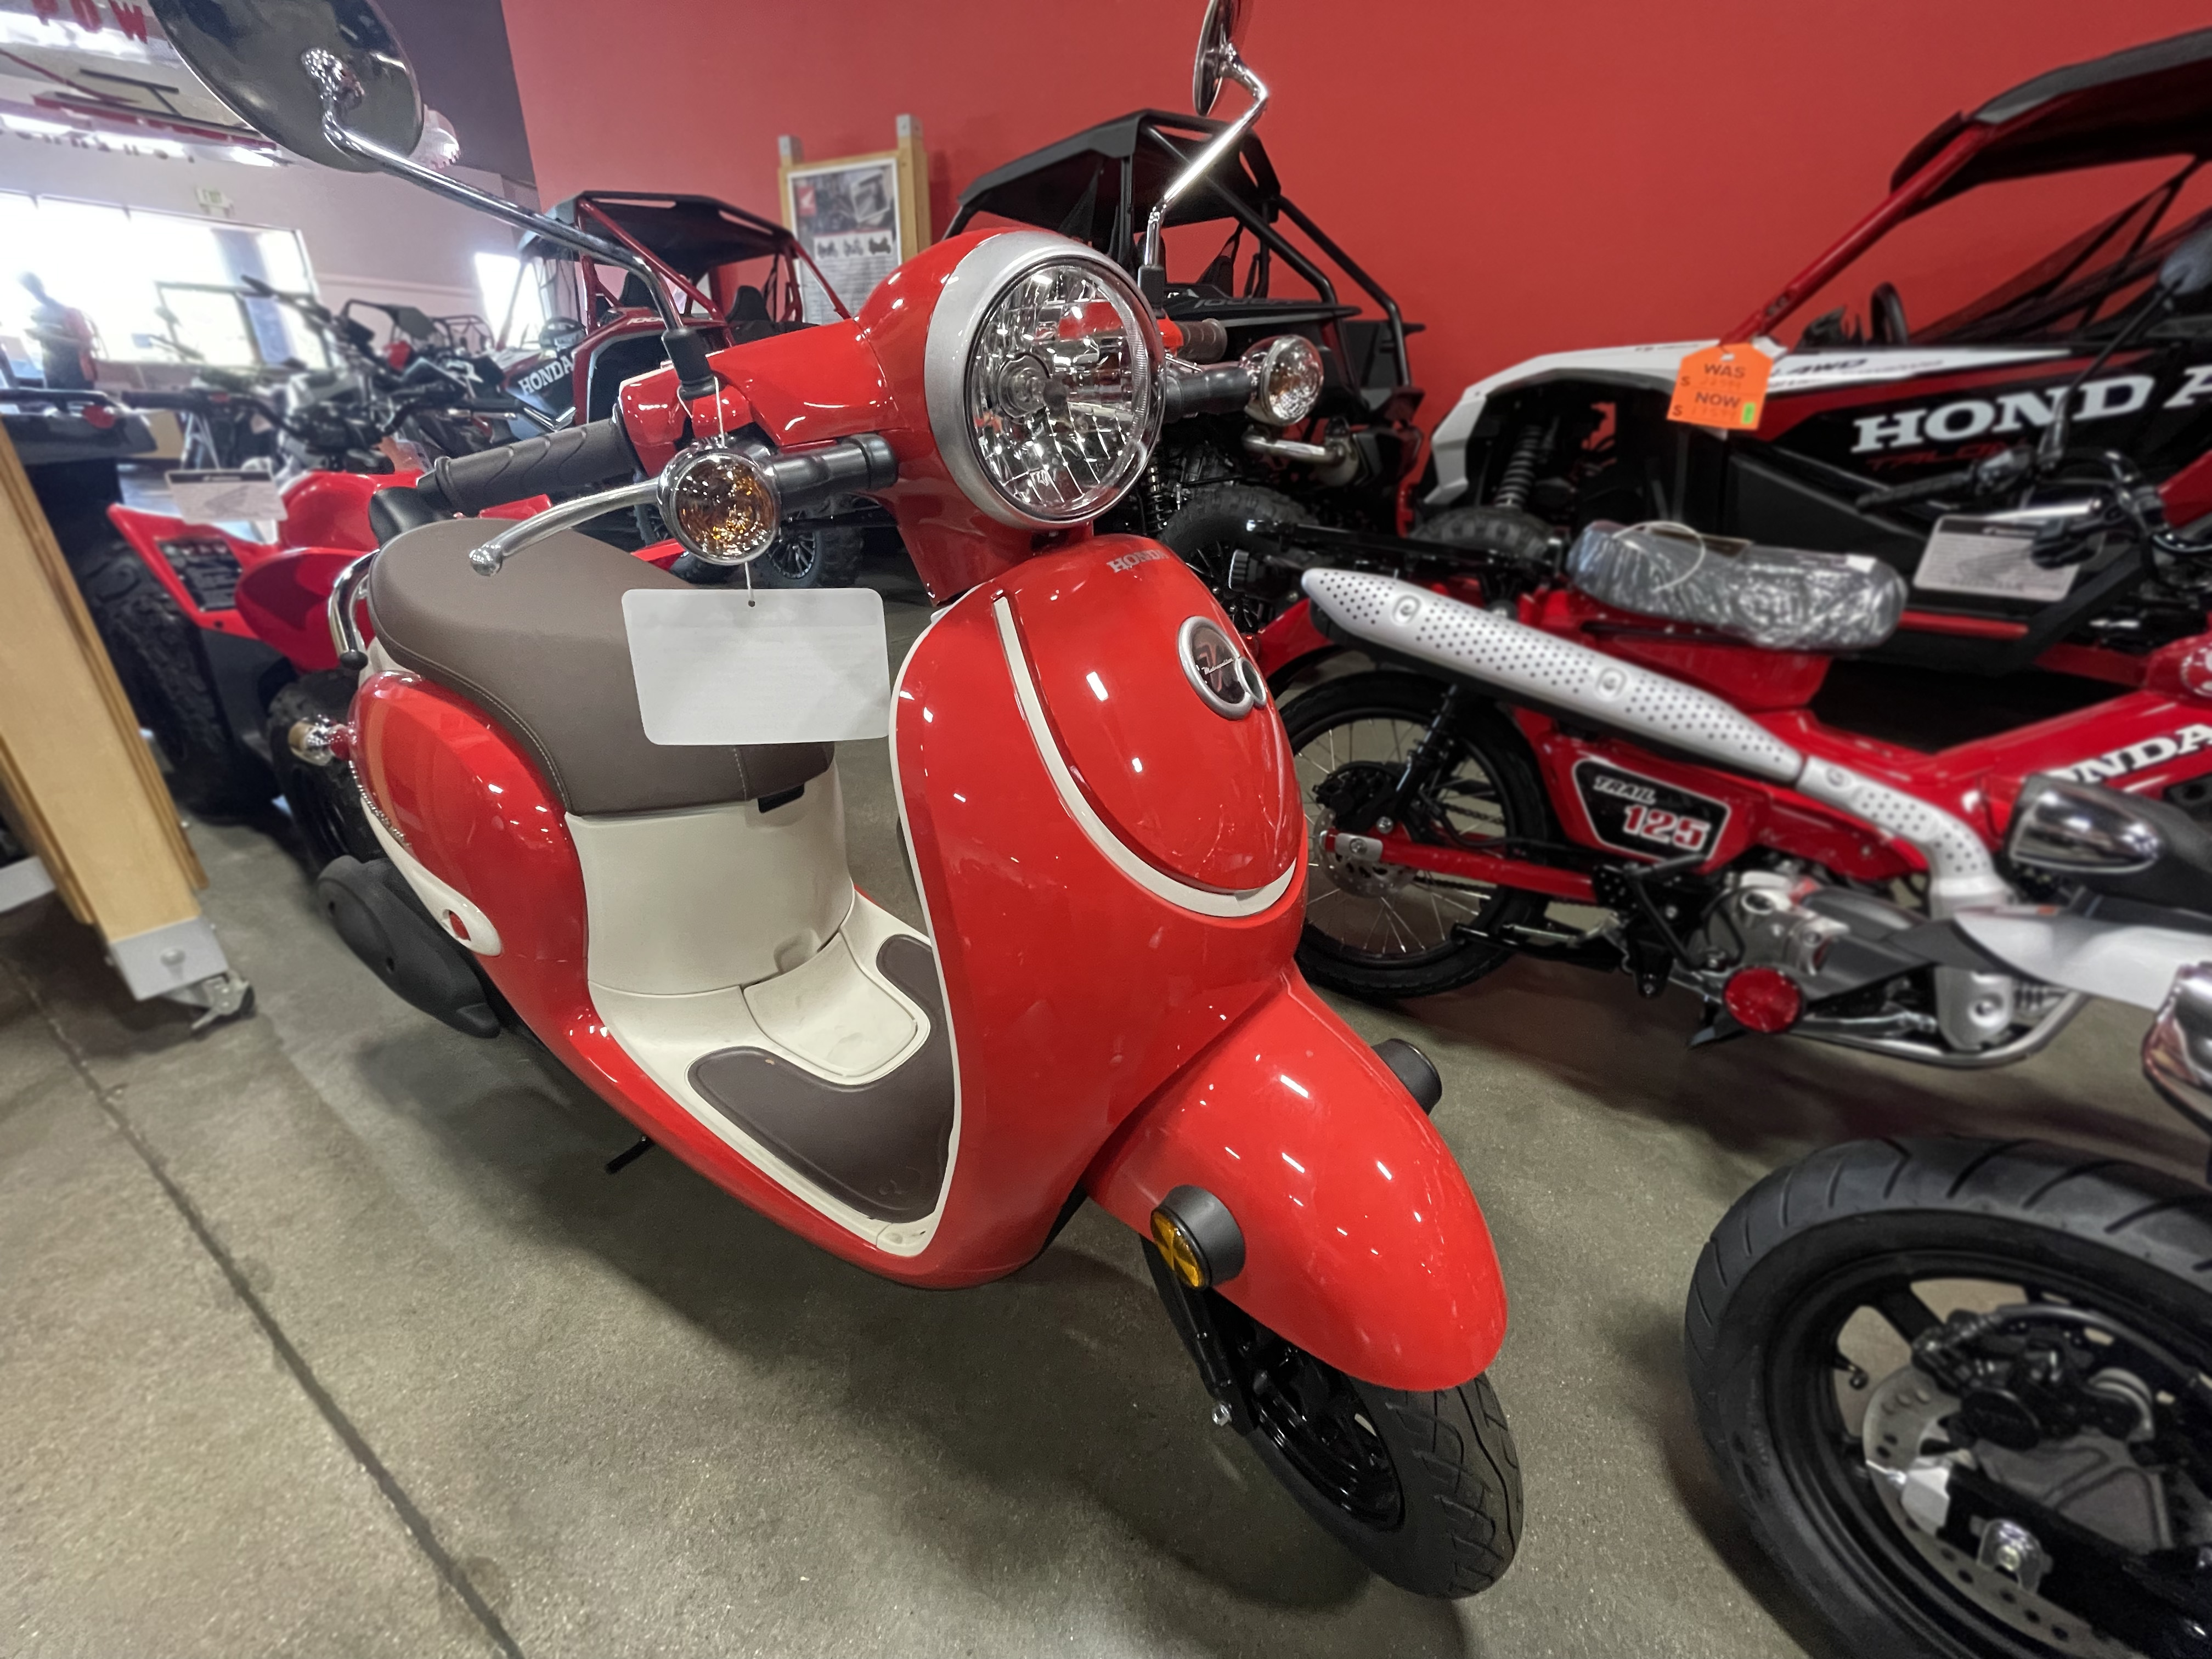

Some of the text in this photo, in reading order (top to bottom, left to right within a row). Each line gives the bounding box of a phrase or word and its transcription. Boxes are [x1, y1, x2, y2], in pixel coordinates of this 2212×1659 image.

[518, 355, 574, 394] HONDA
[1704, 363, 1746, 379] WAS
[1695, 391, 1741, 408] NOW
[1850, 365, 2212, 453] HONDA
[1106, 549, 1170, 573] HONDA
[2046, 723, 2212, 784] NDA
[1622, 803, 1711, 852] 125
